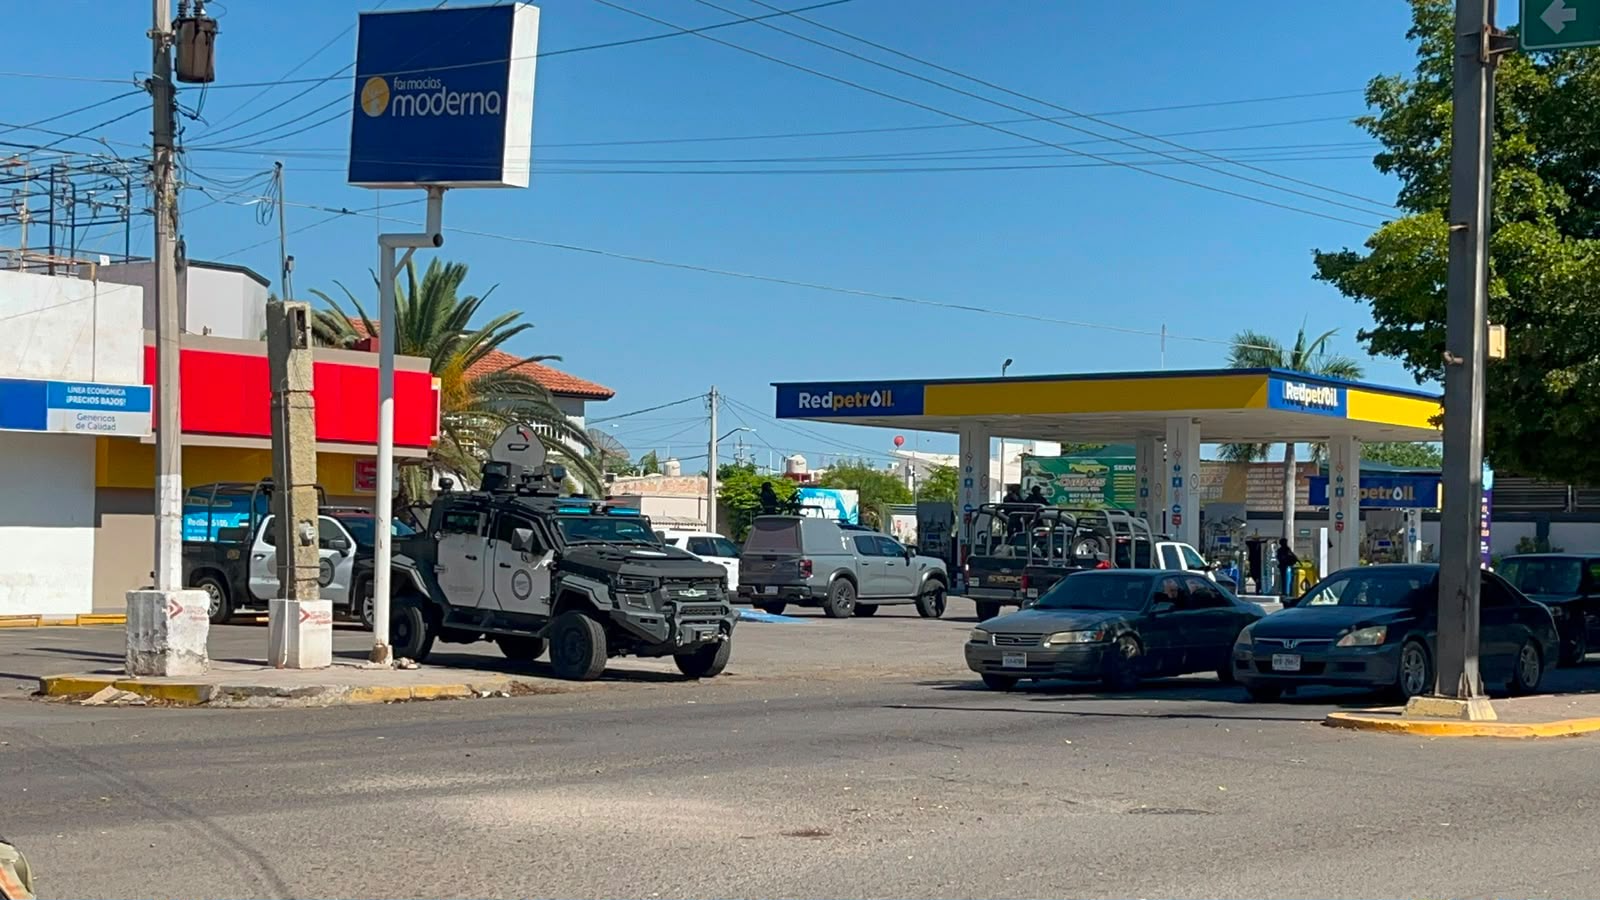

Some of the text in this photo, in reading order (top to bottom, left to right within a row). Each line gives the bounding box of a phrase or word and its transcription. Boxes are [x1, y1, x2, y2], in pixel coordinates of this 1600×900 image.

[393, 77, 441, 90] farmacias
[392, 86, 501, 116] moderna
[100, 397, 126, 406] BAJOS!
[75, 421, 116, 431] de Calidad
